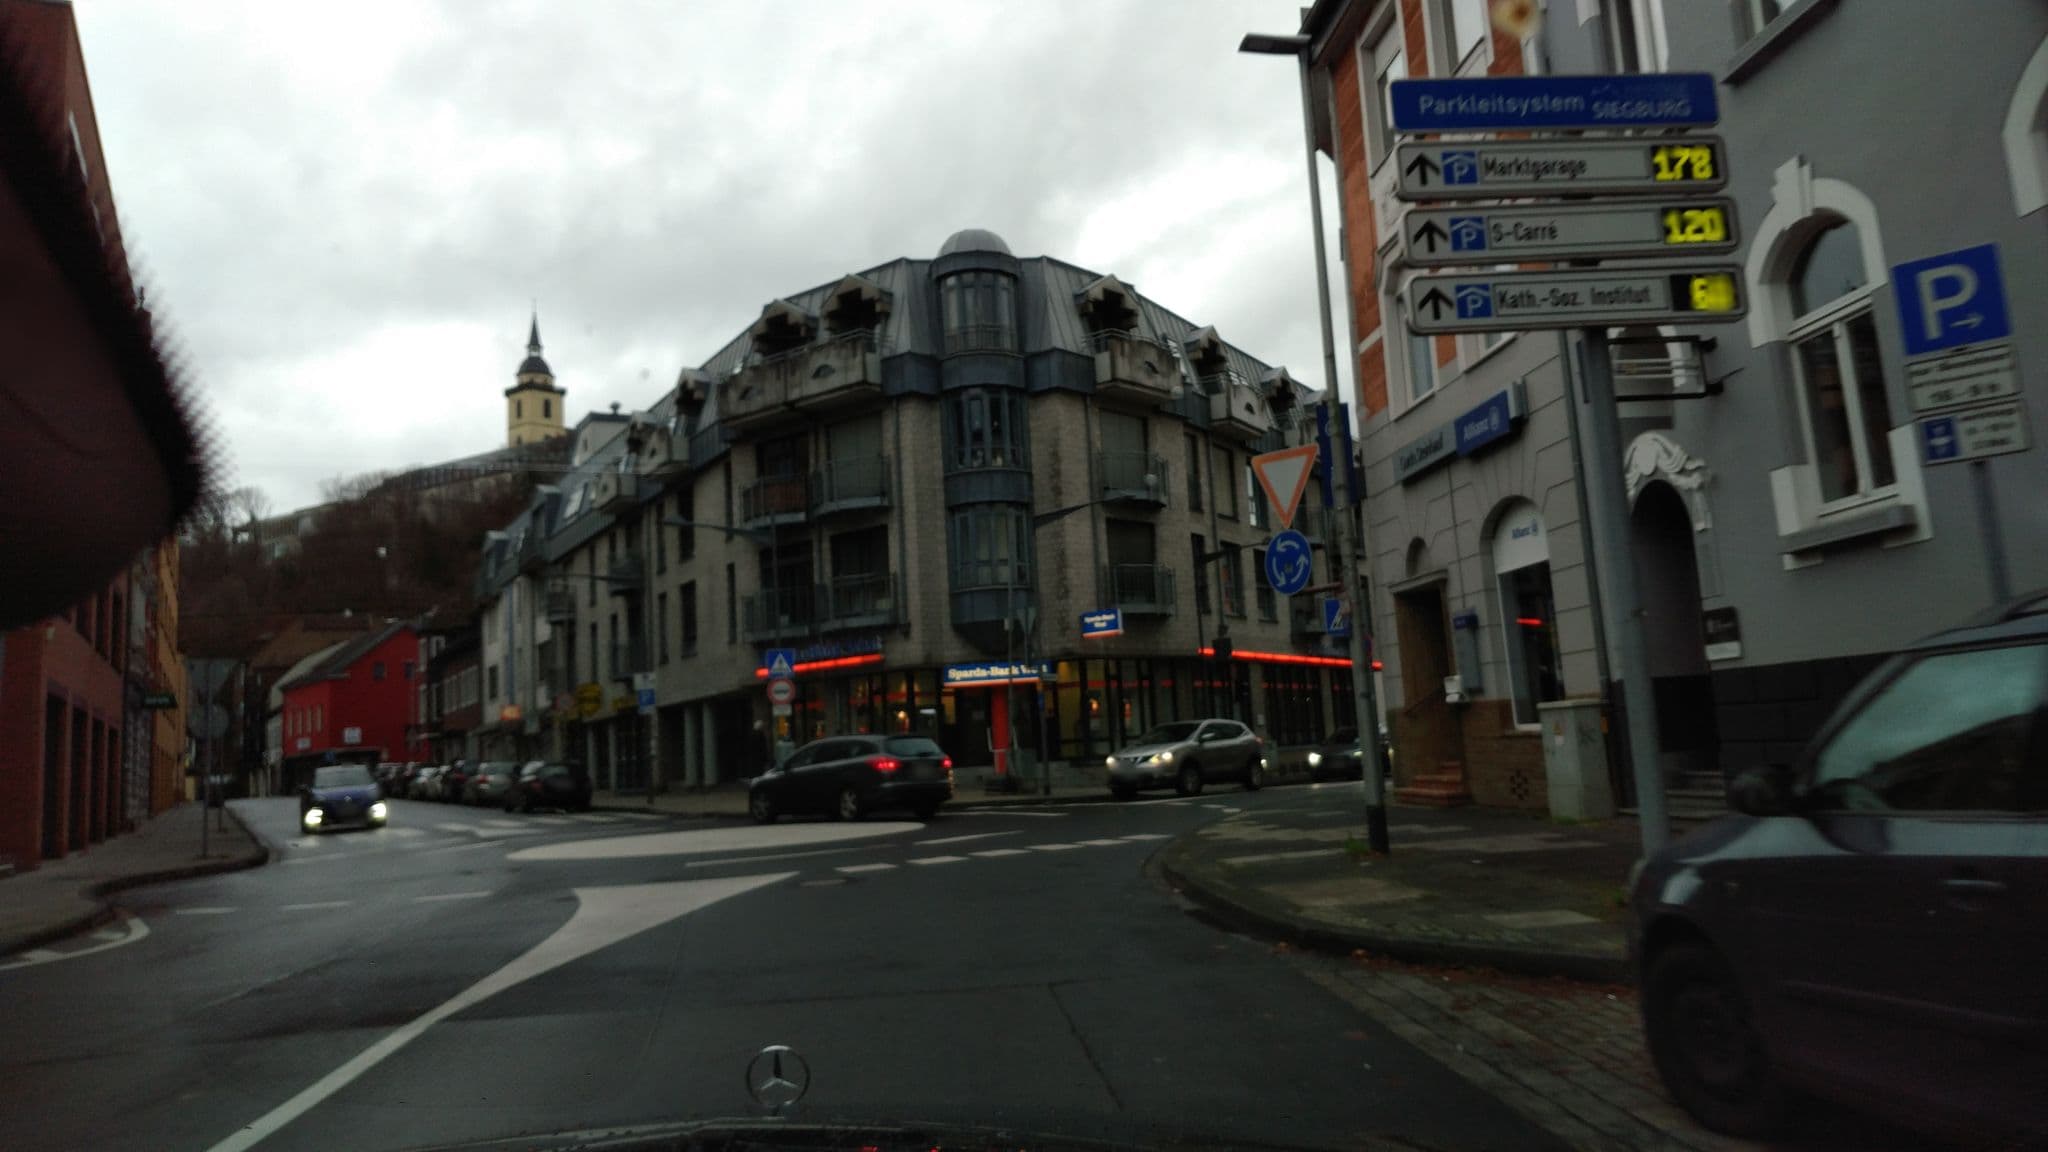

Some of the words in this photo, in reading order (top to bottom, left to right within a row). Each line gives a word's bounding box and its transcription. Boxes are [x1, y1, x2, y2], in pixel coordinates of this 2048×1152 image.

[1419, 92, 1585, 118] Parkleitsystem
[1591, 98, 1693, 120] SIEGBURG
[1484, 156, 1587, 180] Marktgarage
[1653, 147, 1713, 181] 178
[1491, 220, 1558, 244] S-Carré
[1664, 208, 1725, 243] 120
[1918, 264, 1979, 341] P
[1463, 418, 1489, 441] Allianz
[947, 664, 1019, 682] Sparda-Bank
[1020, 663, 1048, 675] Wt
